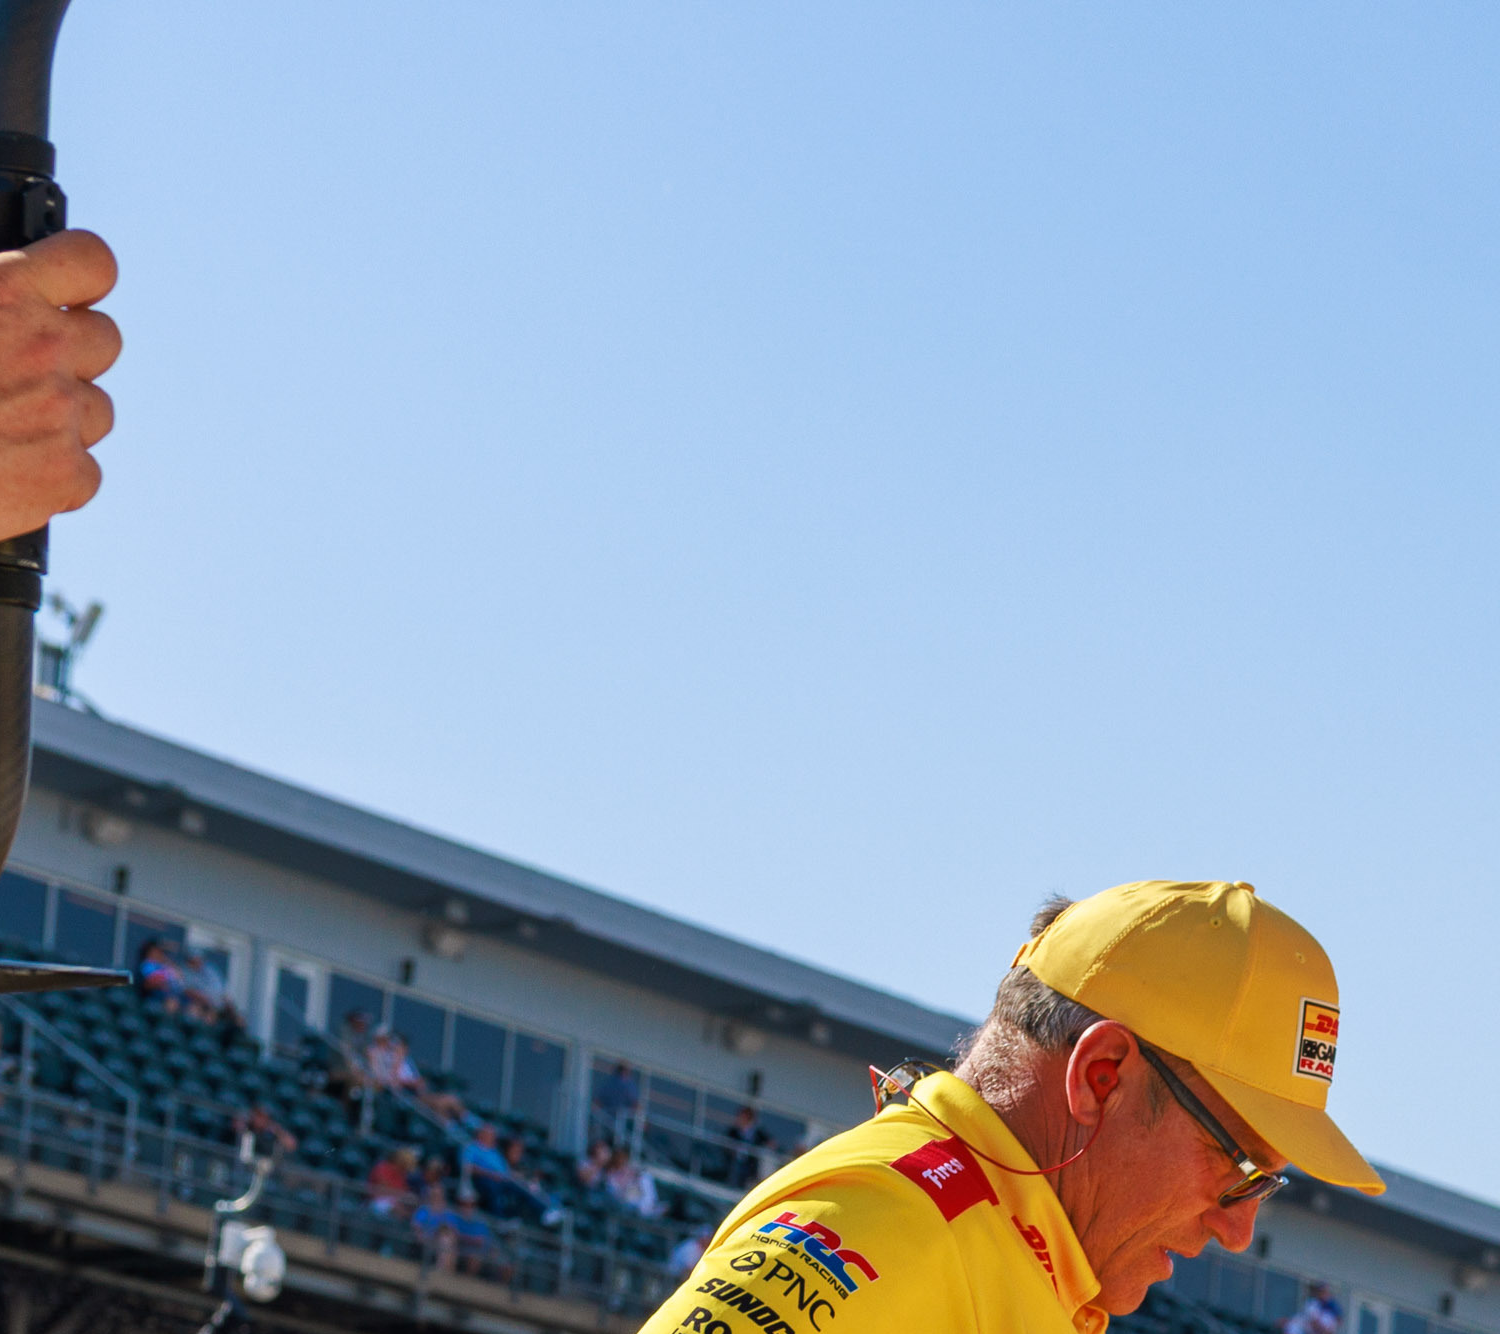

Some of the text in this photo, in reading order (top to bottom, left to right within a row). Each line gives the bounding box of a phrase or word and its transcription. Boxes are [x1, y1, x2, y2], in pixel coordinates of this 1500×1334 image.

[1300, 1057, 1334, 1078] RAC
[750, 1232, 850, 1301] Honda RACING
[757, 1210, 880, 1294] HRC
[763, 1257, 836, 1333] PNC
